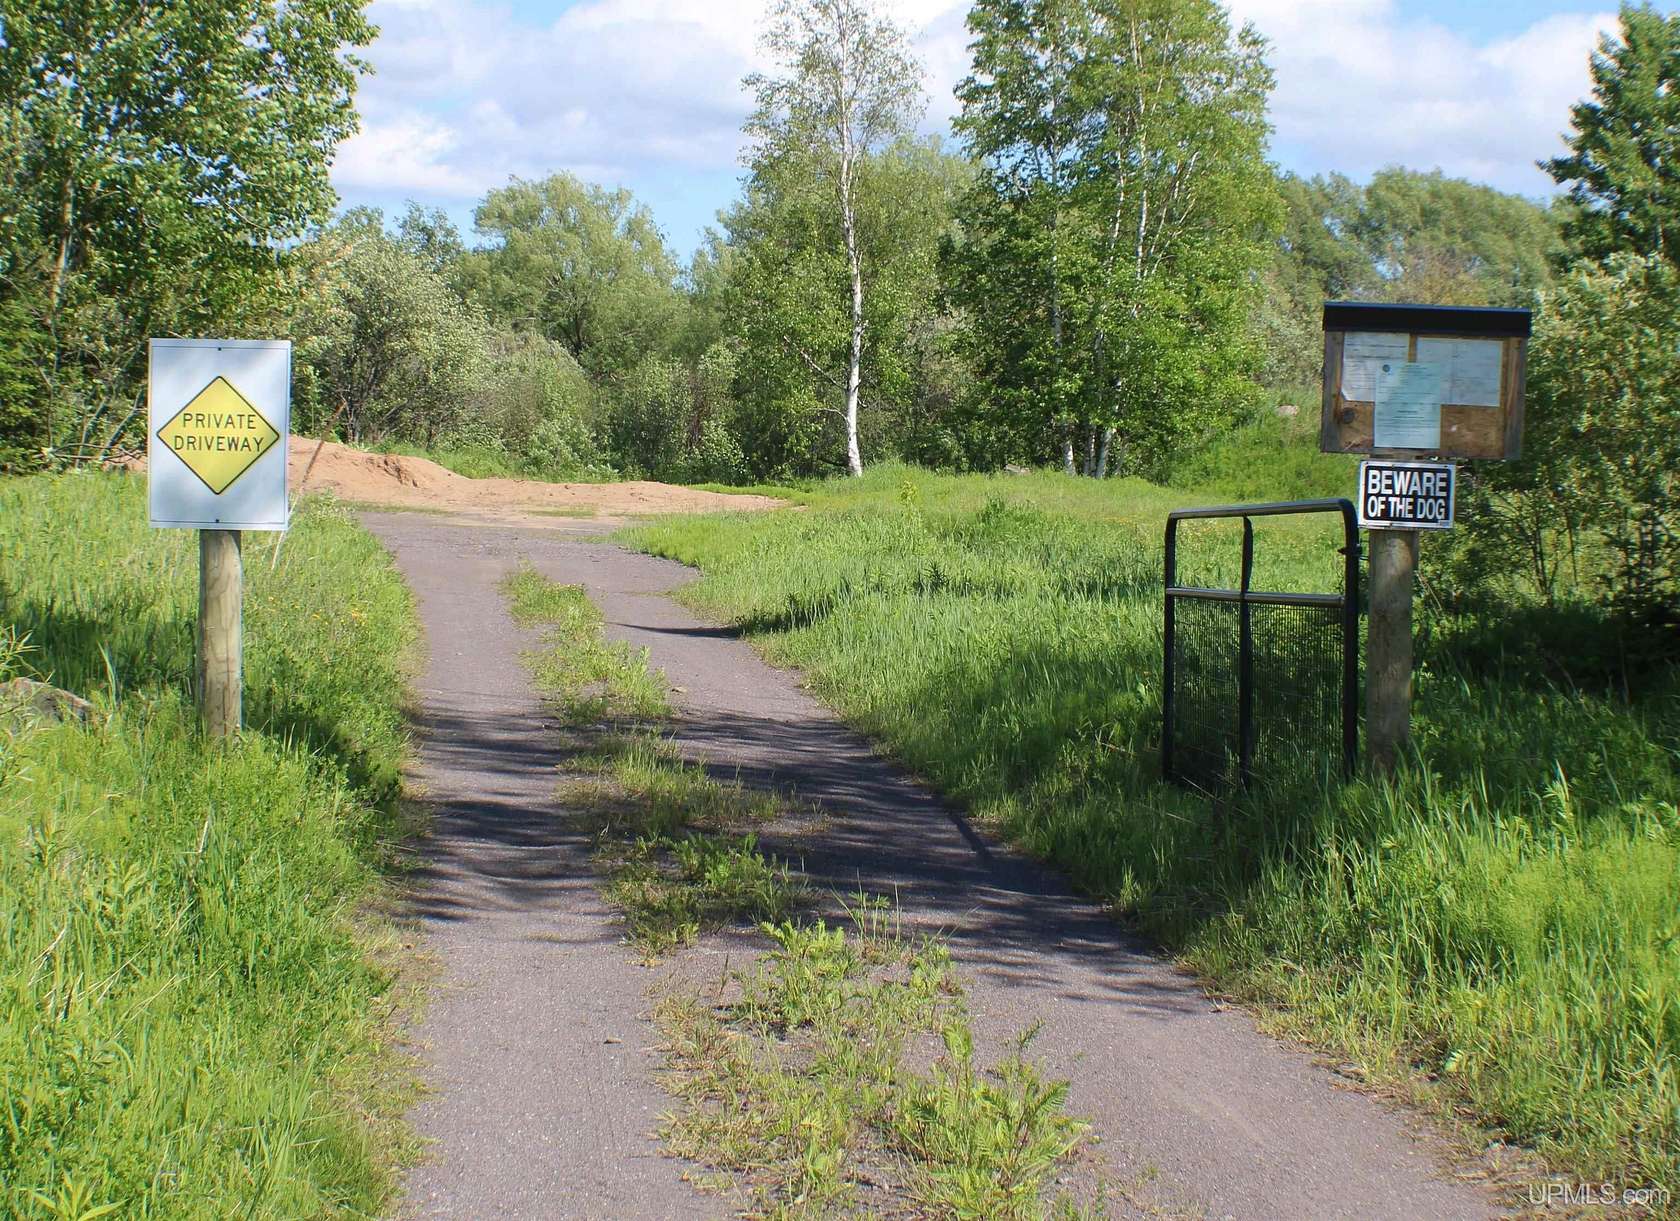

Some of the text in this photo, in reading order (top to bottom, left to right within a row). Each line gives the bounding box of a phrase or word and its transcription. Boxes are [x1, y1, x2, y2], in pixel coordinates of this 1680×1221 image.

[183, 413, 257, 429] PRIVATE
[174, 435, 264, 452] DRIVEWAY
[1367, 469, 1448, 497] BEWARE
[1367, 495, 1446, 520] OF THE DOG
